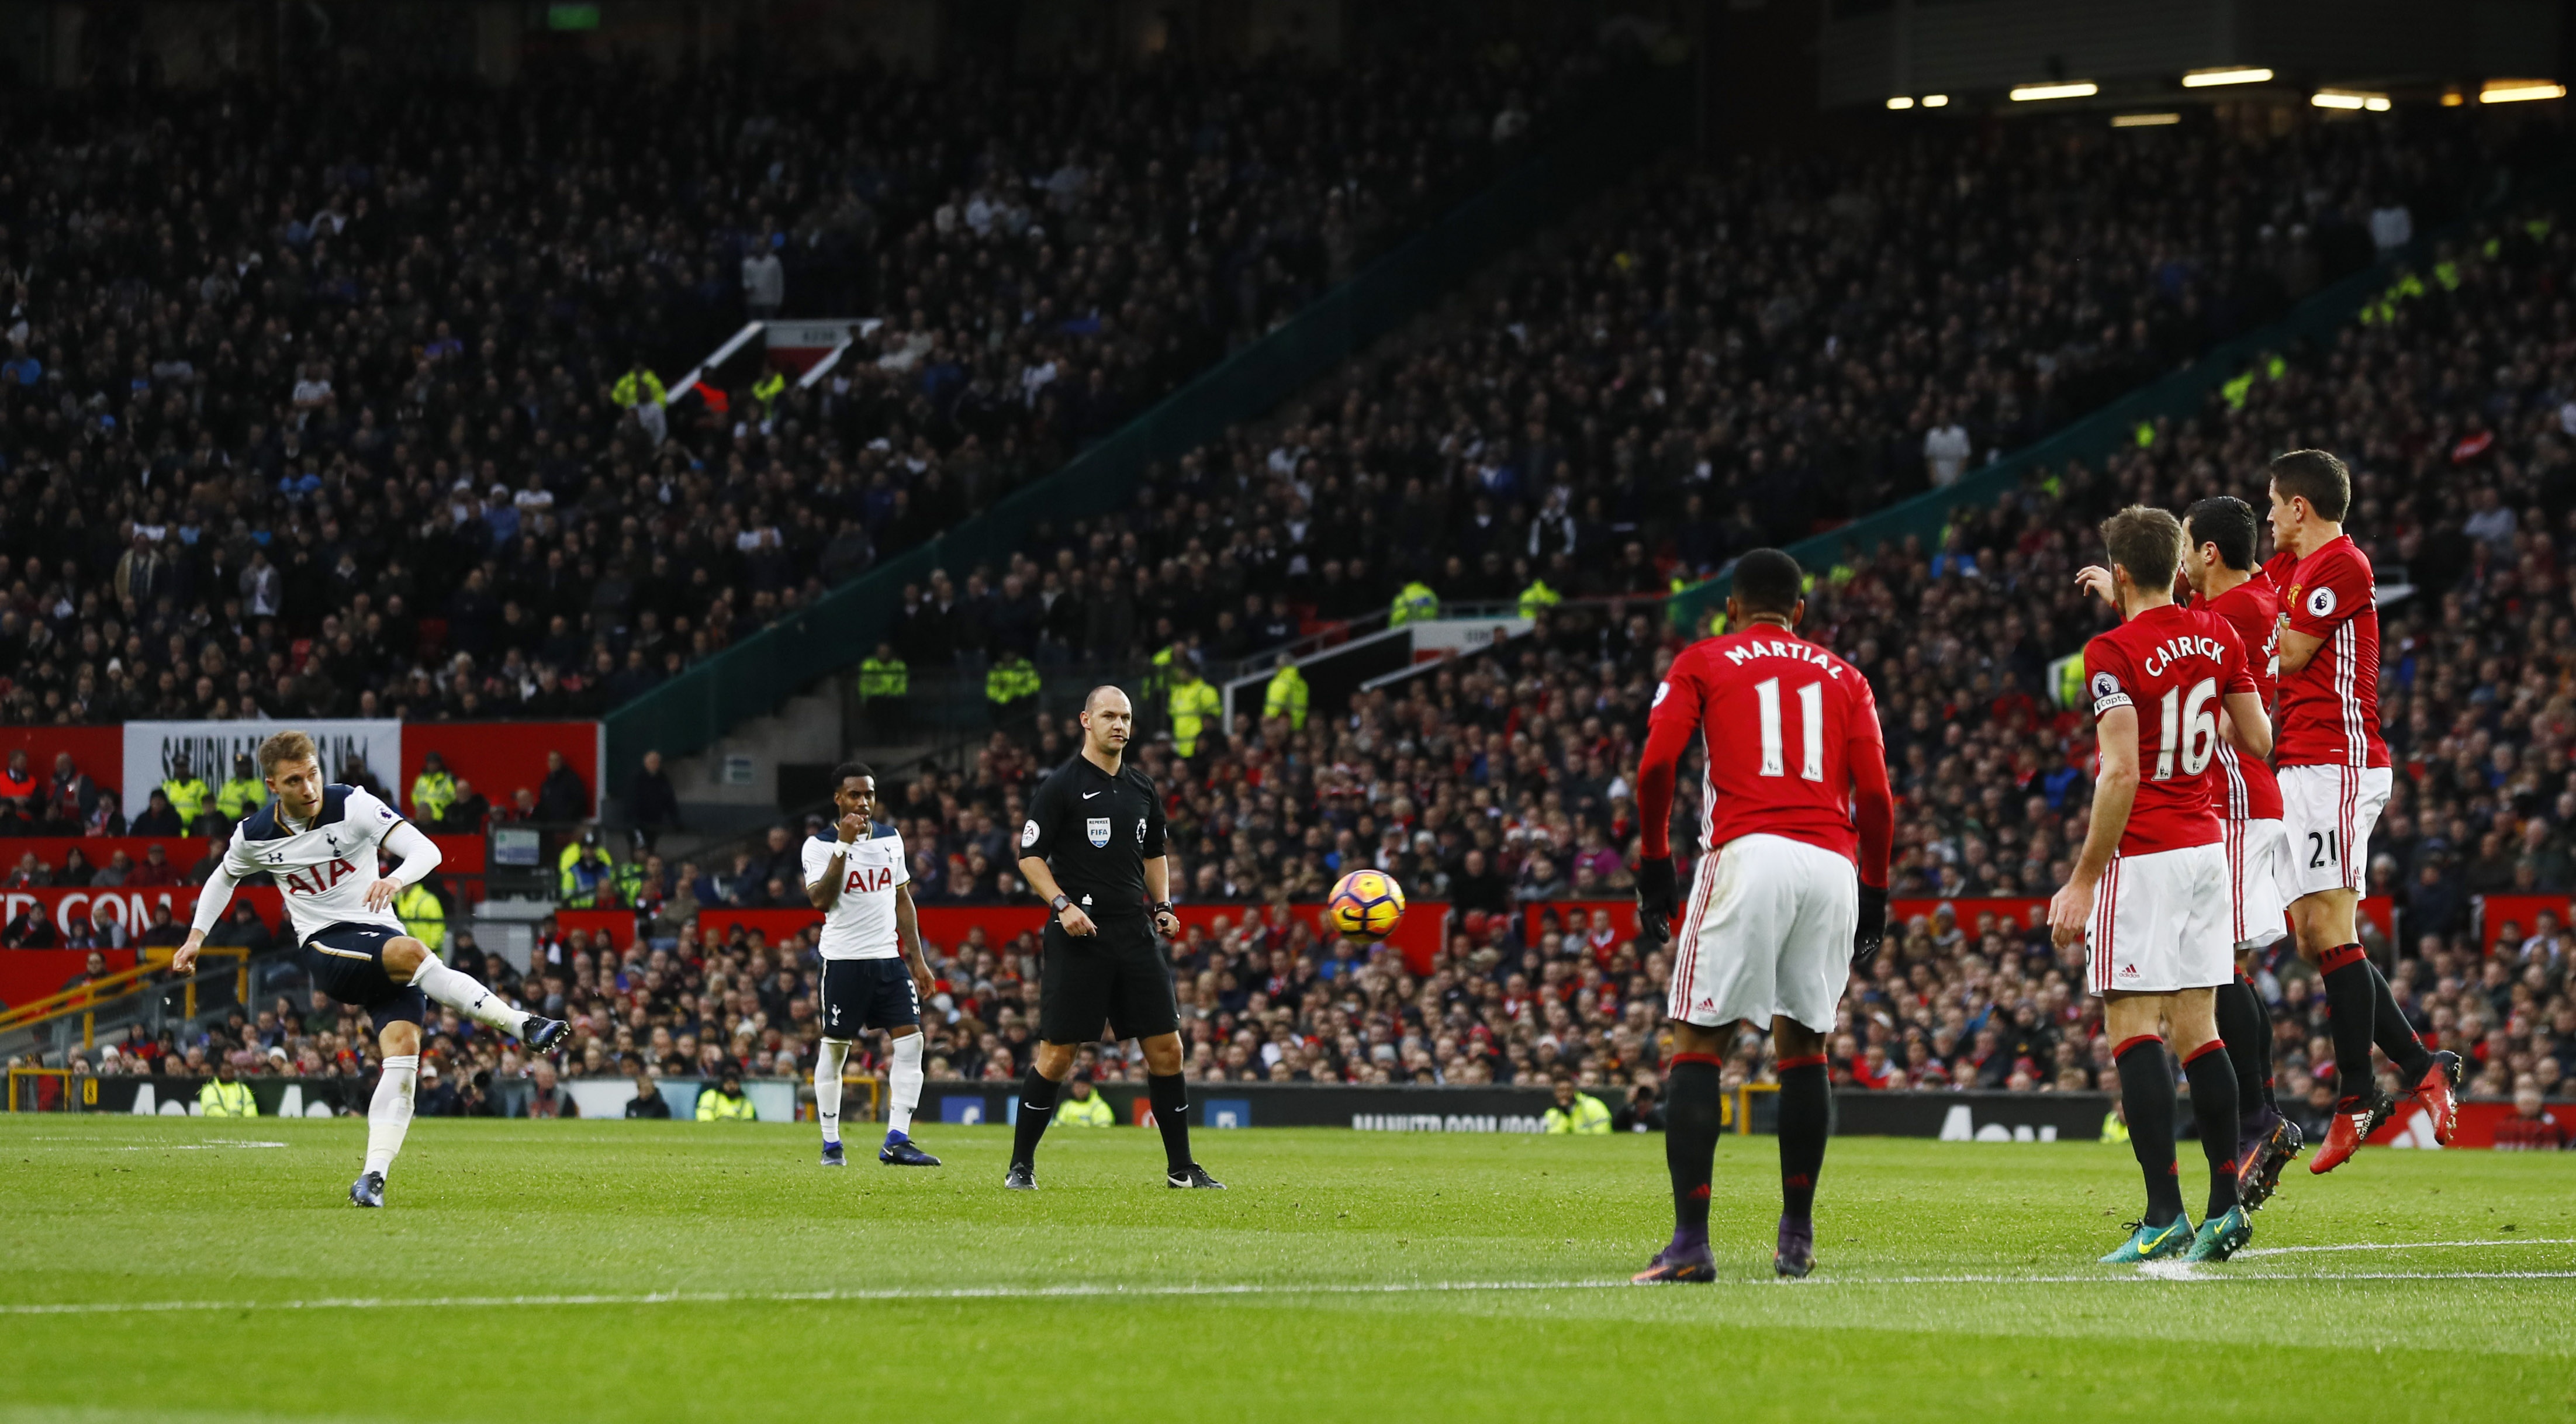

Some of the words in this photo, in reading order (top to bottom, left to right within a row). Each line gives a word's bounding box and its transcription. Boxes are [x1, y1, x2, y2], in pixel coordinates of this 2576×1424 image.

[1724, 640, 1843, 679] MARTIAL
[2145, 635, 2225, 677] CARRICK
[1755, 676, 1823, 782] 11
[2151, 677, 2217, 781] 16
[2308, 828, 2338, 869] 21
[286, 858, 357, 895] AIA
[844, 867, 892, 894] AIA
[2359, 1109, 2374, 1140] adidas
